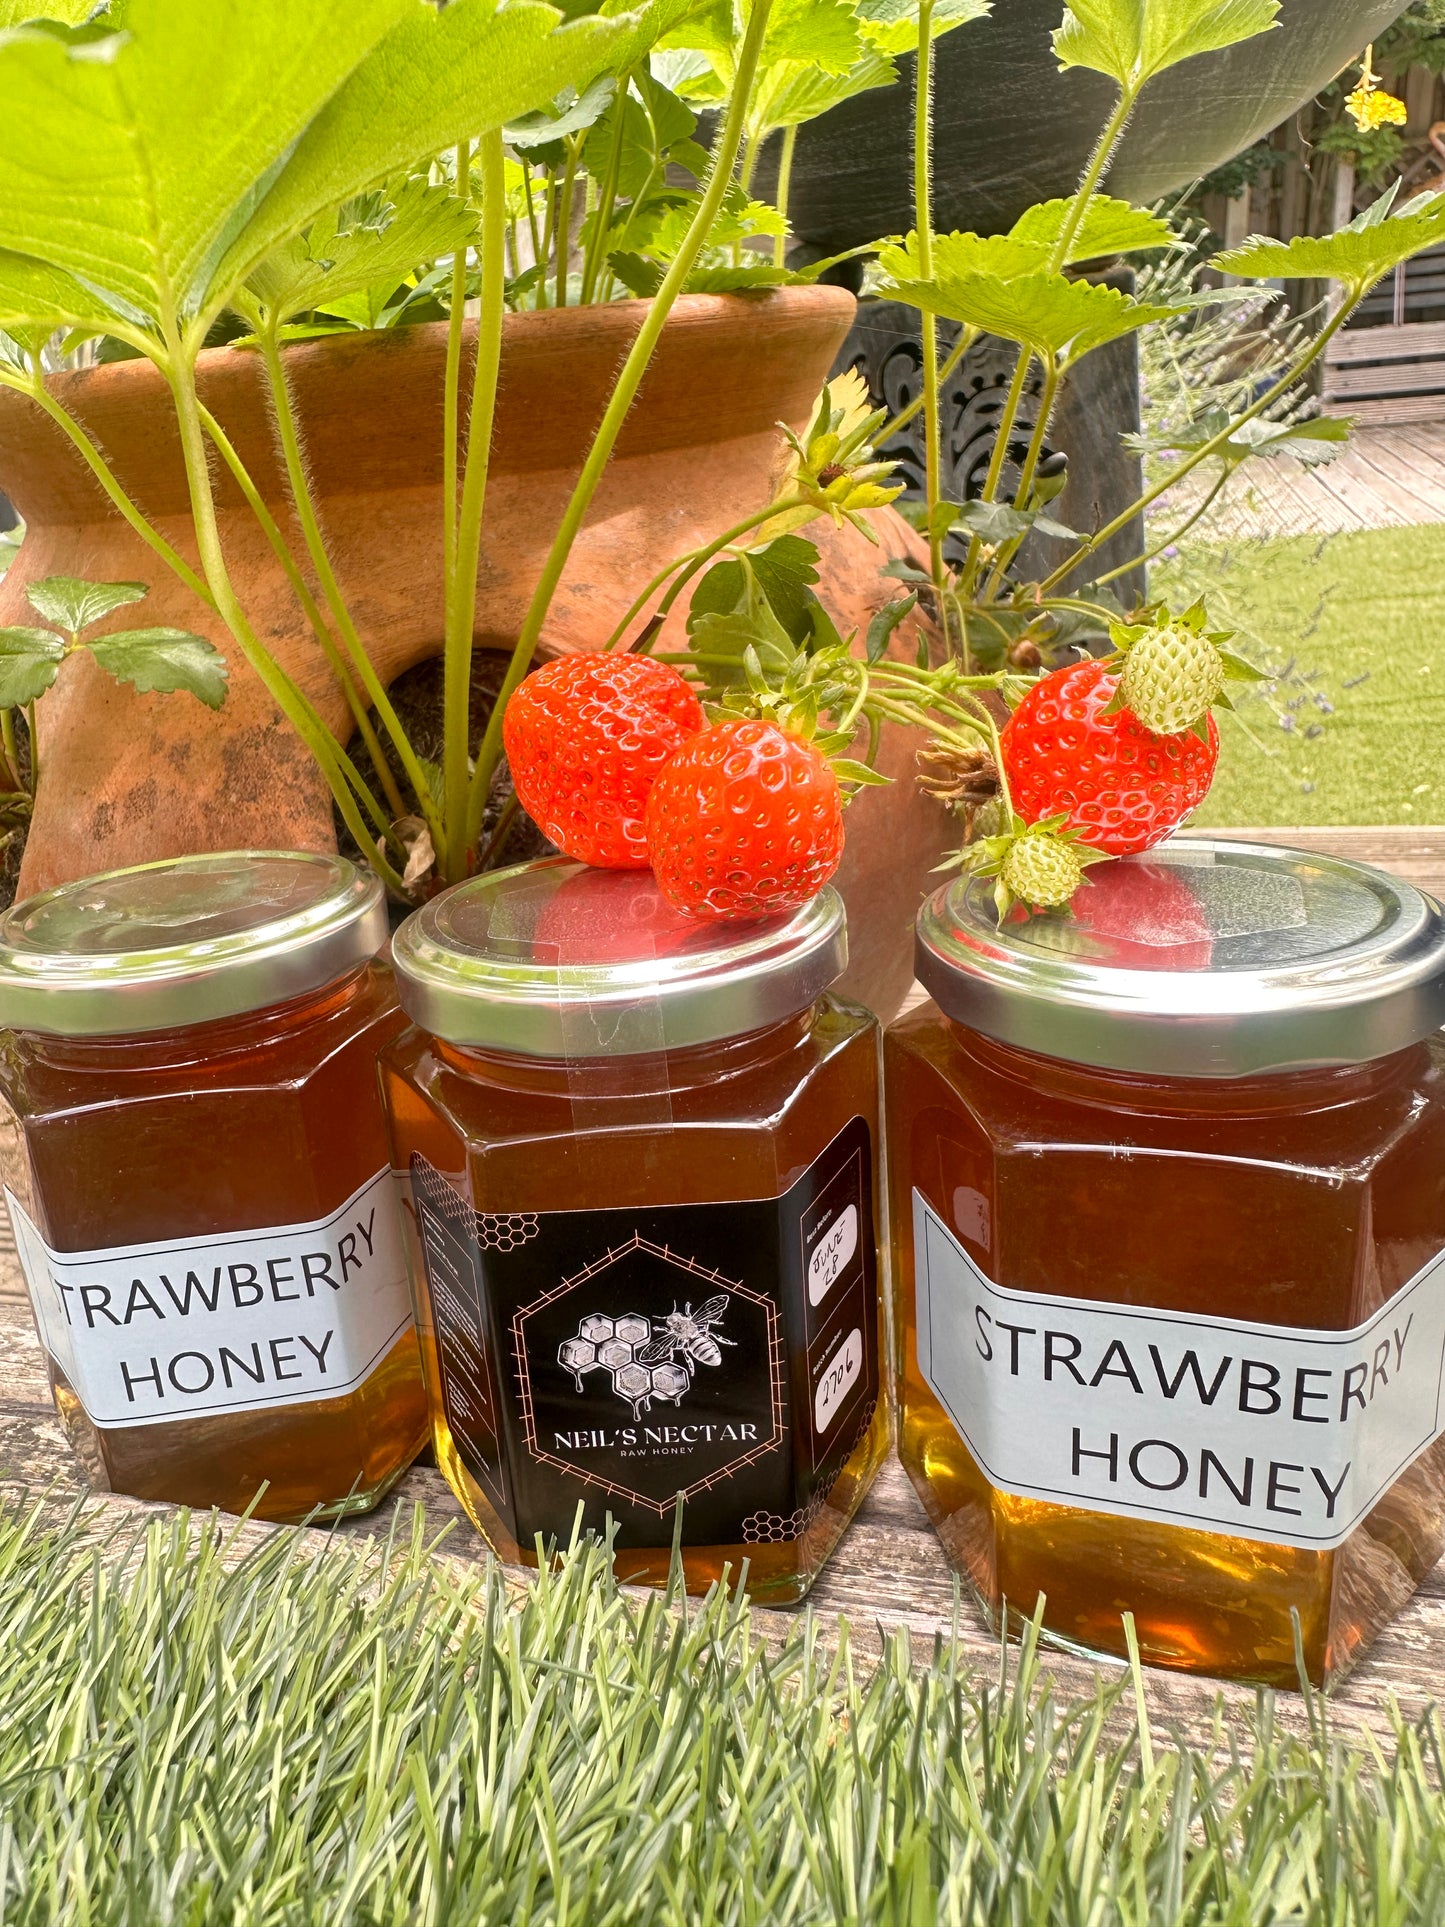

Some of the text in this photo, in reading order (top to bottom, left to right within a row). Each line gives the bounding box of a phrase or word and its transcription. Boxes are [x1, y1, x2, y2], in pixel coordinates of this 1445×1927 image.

[119, 1329, 334, 1403] HONEY
[974, 1304, 1414, 1424] STRAWBERRY
[554, 1423, 758, 1450] NEIL'S NECTAR
[620, 1446, 695, 1457] RAW HONEY
[1071, 1426, 1352, 1519] HONEY
